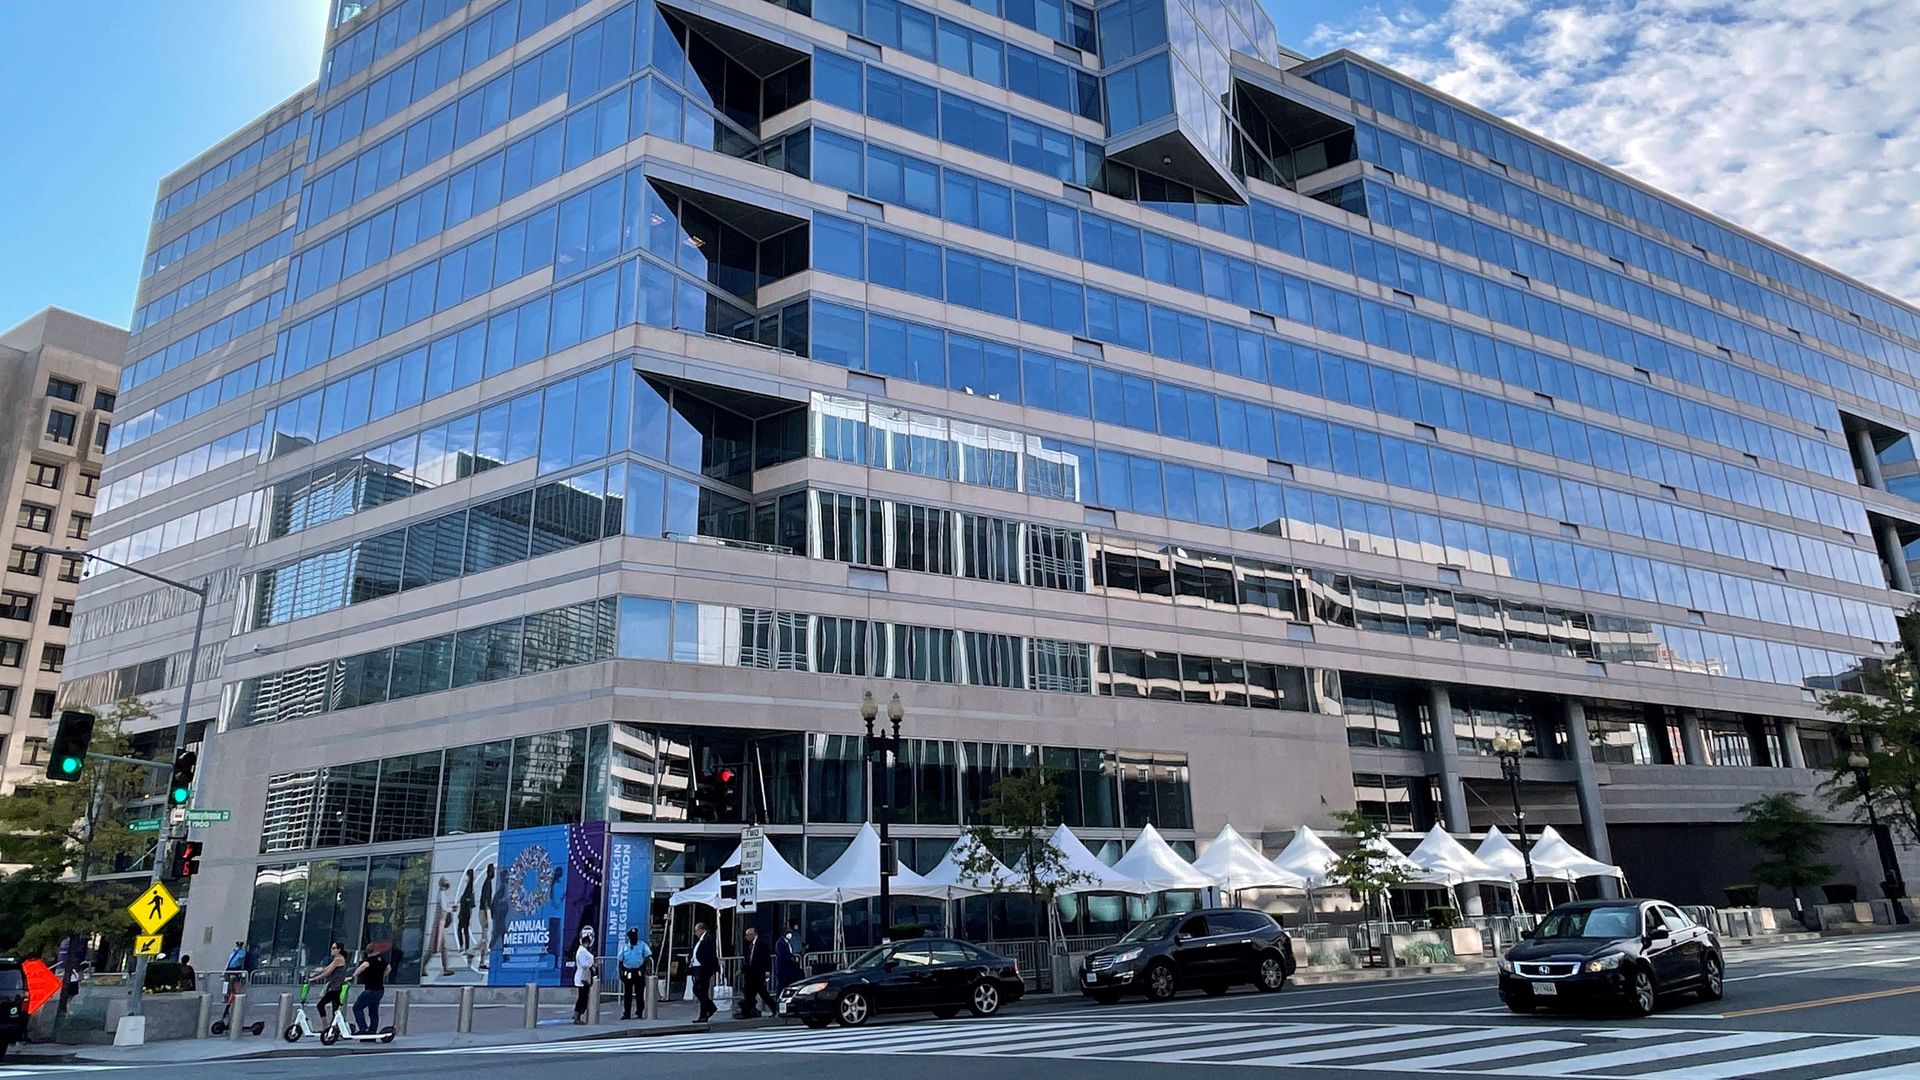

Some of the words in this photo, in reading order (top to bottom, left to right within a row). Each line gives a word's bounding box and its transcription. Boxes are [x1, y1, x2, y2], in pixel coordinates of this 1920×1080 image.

[745, 829, 760, 837] TWO
[611, 844, 622, 907] CHECK-IN
[740, 876, 754, 886] ONE
[618, 844, 631, 940] REGISTRATION
[739, 886, 754, 896] WAY
[507, 919, 547, 932] ANNUAL
[609, 910, 618, 935] IMF
[503, 931, 550, 945] MEETINGS
